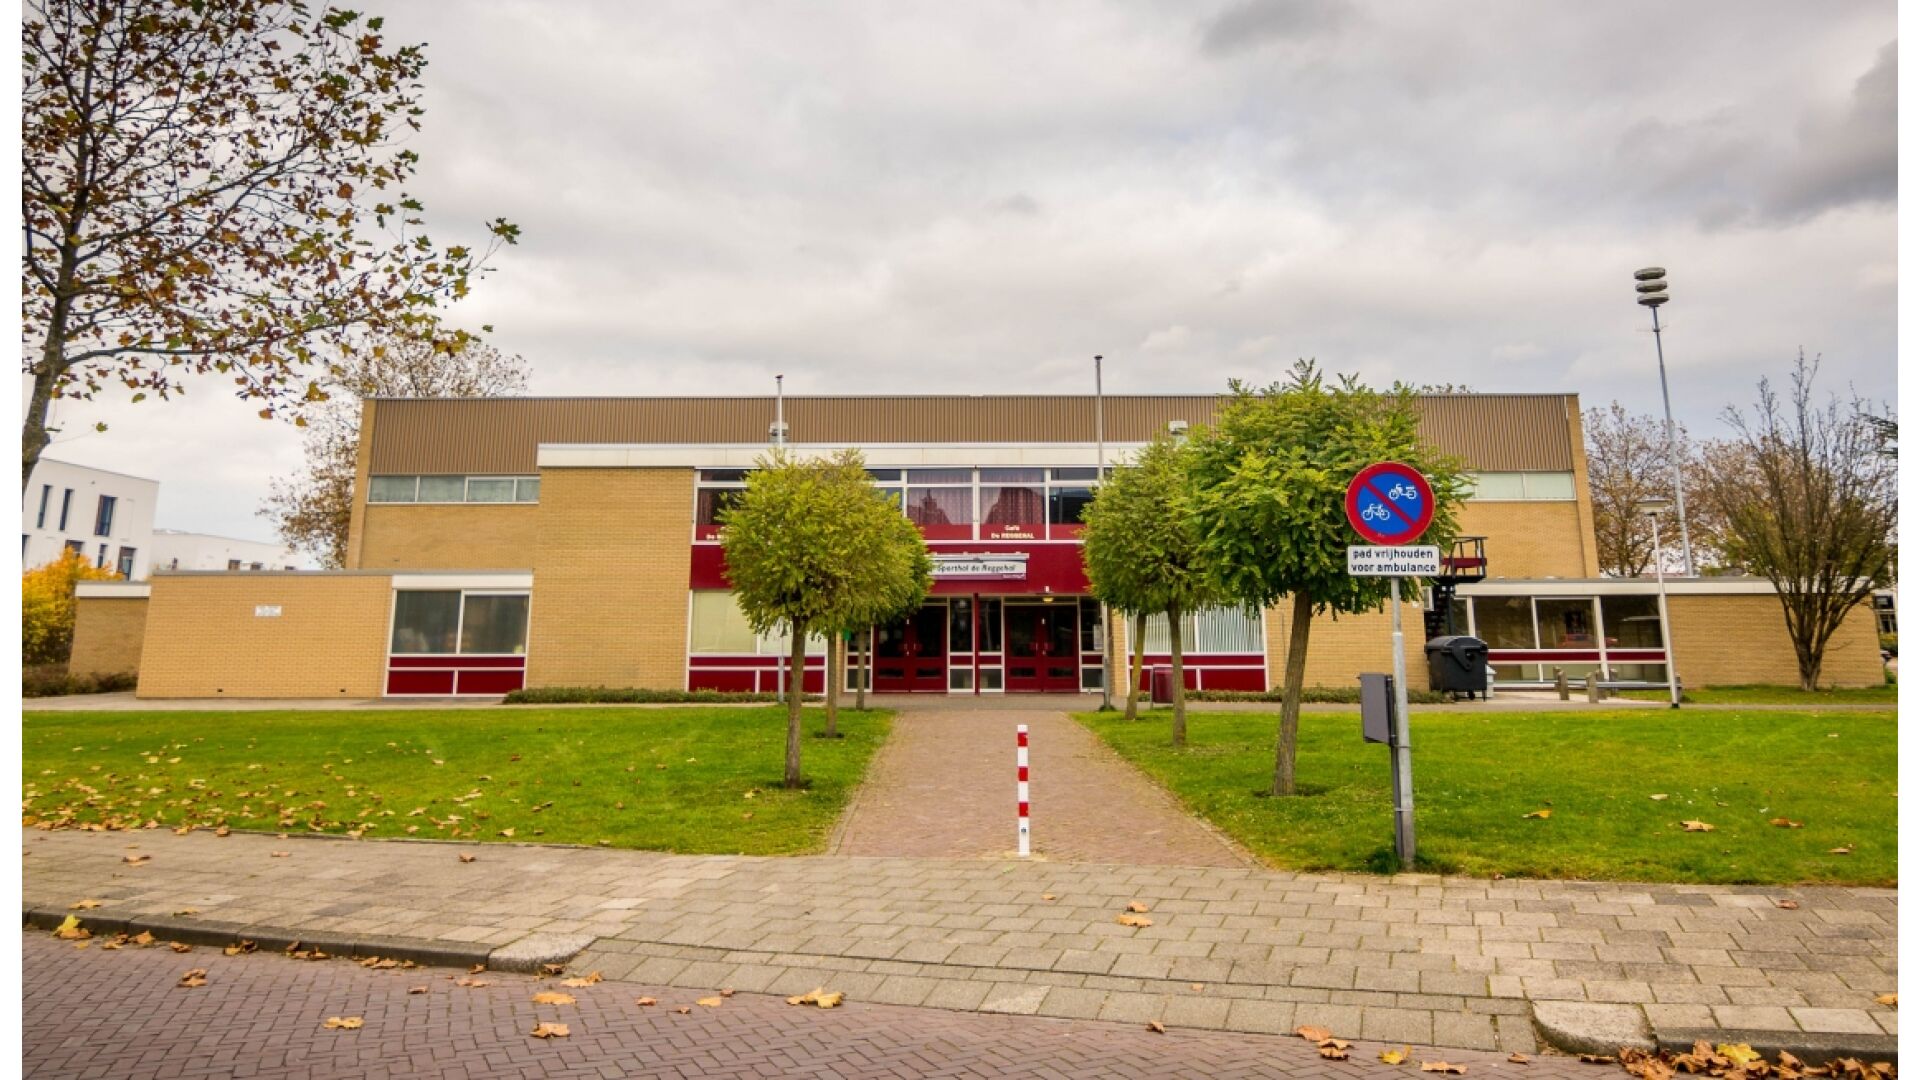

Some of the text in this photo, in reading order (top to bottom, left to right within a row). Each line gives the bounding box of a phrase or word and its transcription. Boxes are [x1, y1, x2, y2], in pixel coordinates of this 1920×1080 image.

[1353, 548, 1433, 560] pad vrijhouden
[1351, 562, 1436, 572] voor ambulance
